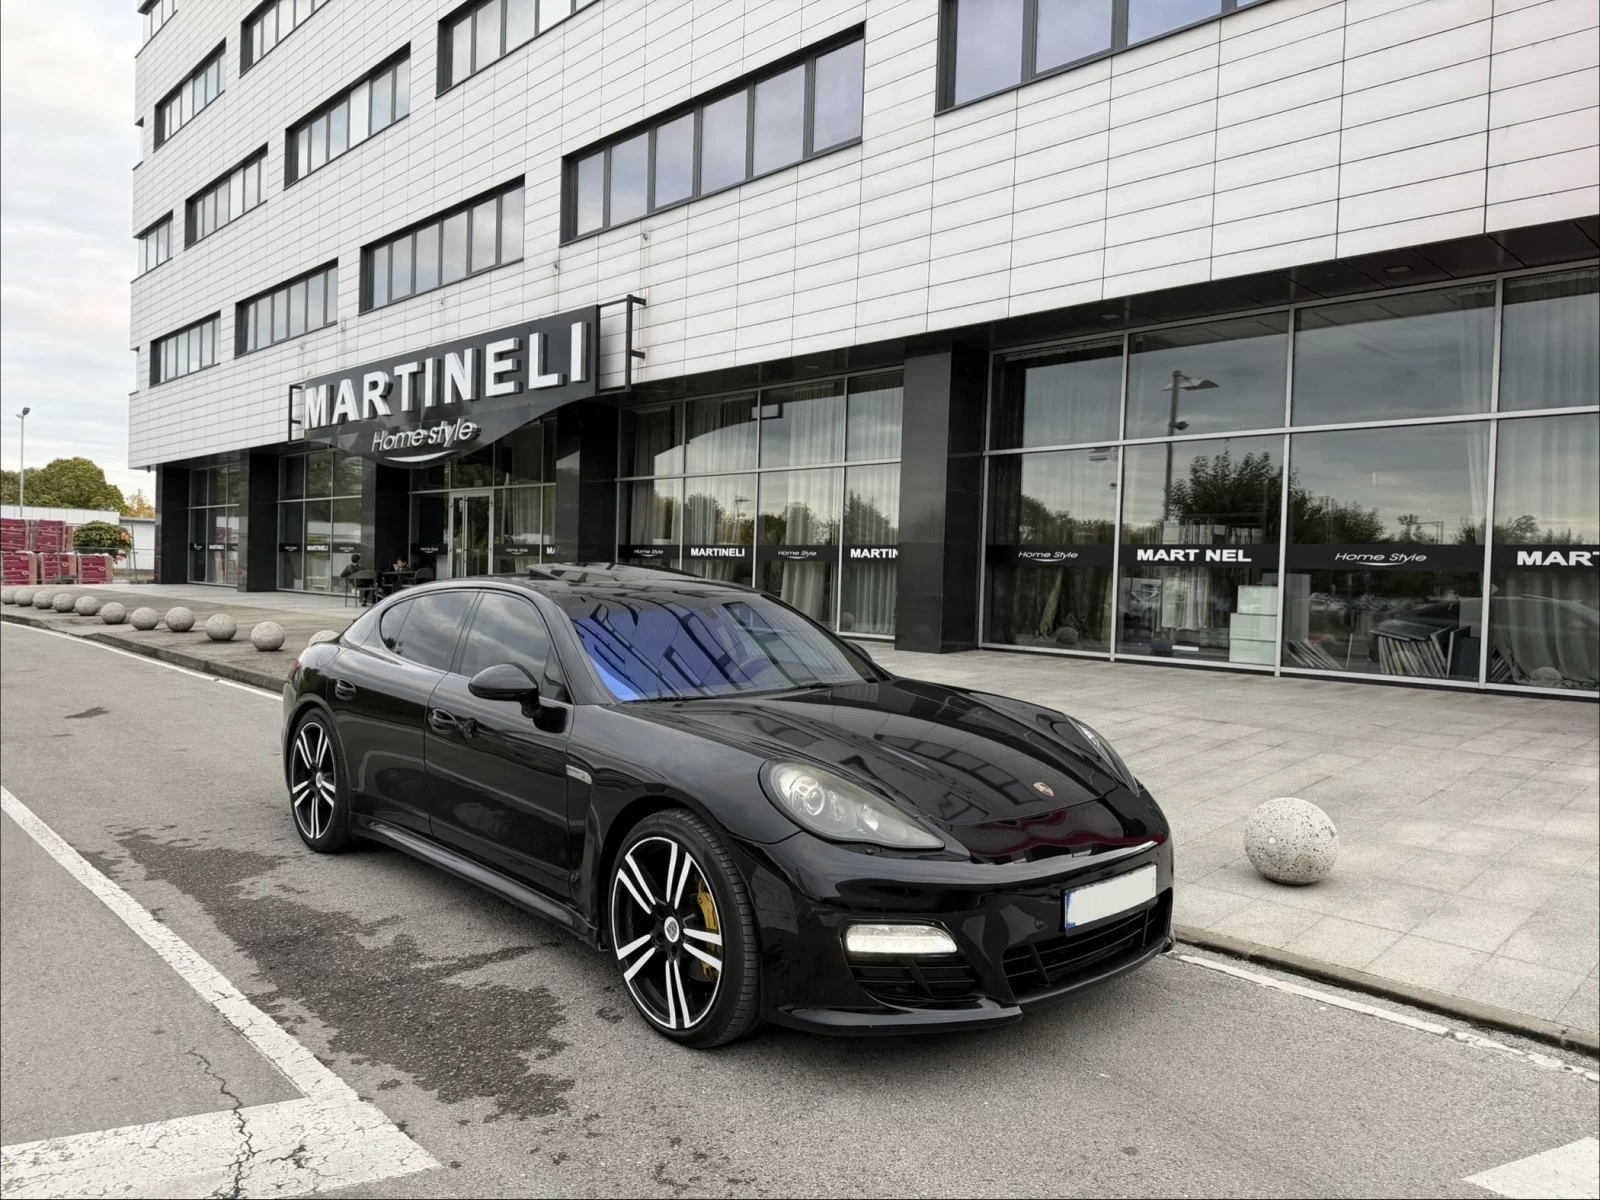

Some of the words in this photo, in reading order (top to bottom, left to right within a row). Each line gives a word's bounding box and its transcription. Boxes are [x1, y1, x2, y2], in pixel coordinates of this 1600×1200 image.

[304, 321, 591, 429] MARTINELI
[371, 428, 428, 452] Home
[427, 417, 481, 448] style
[690, 547, 745, 557] MARTINELI
[800, 550, 817, 558] Style
[1053, 551, 1079, 560] Style
[1334, 552, 1386, 561] Home
[1388, 553, 1428, 564] Style
